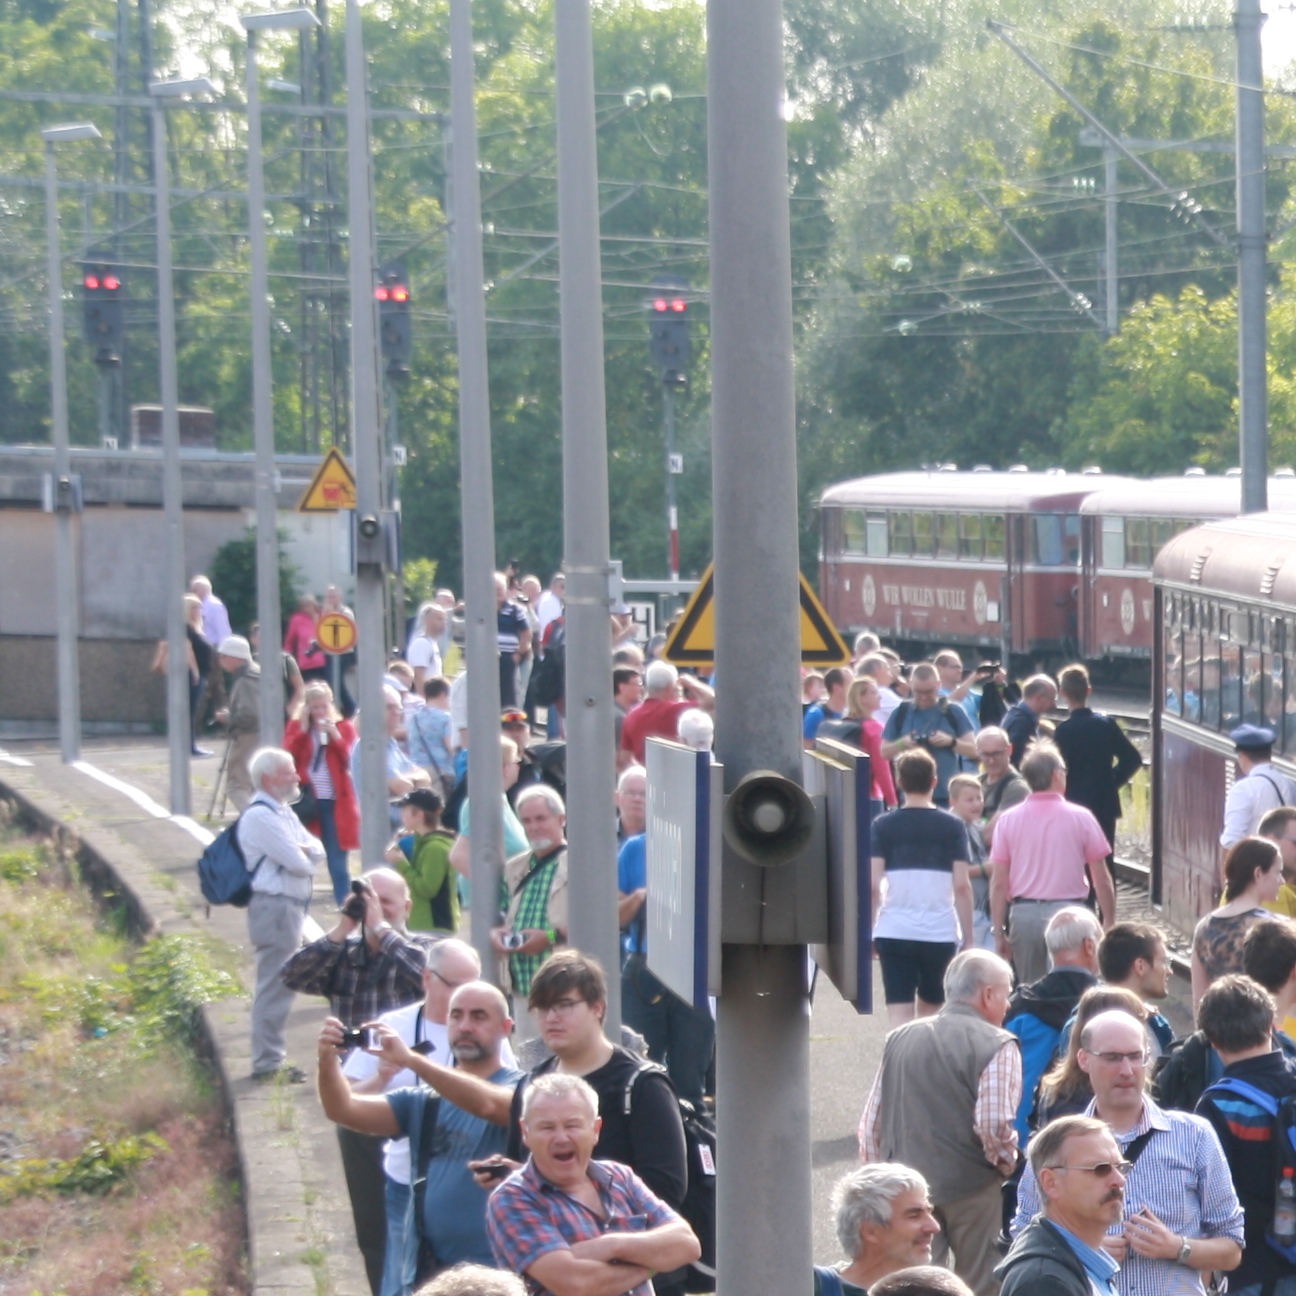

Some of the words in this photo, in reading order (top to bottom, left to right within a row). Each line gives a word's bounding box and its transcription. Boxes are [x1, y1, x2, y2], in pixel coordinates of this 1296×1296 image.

[882, 584, 900, 606] WIR
[901, 585, 935, 607] WOLLEN
[936, 587, 967, 611] WULLE
